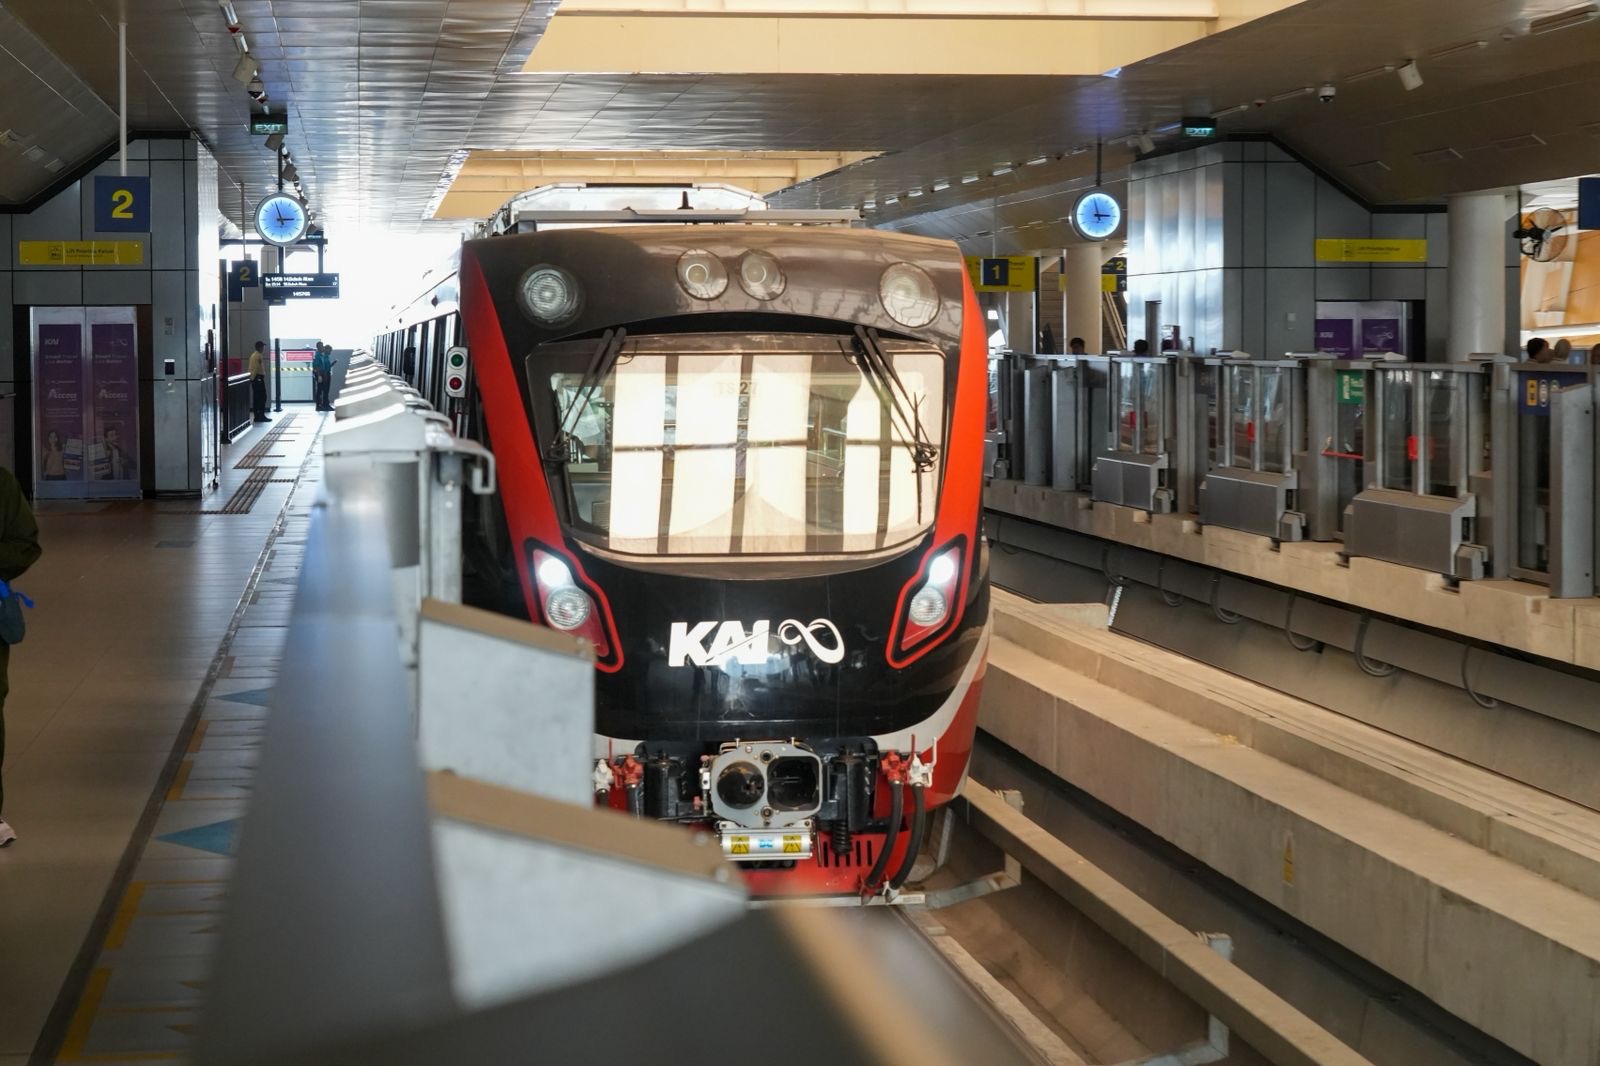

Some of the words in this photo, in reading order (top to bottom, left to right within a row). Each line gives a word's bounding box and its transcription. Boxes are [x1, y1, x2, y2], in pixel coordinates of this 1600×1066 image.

[1185, 127, 1213, 135] EXIT
[111, 190, 134, 219] 2
[240, 266, 251, 281] 2
[991, 264, 1000, 280] 1
[1116, 261, 1125, 271] 2
[668, 619, 770, 667] KAI
